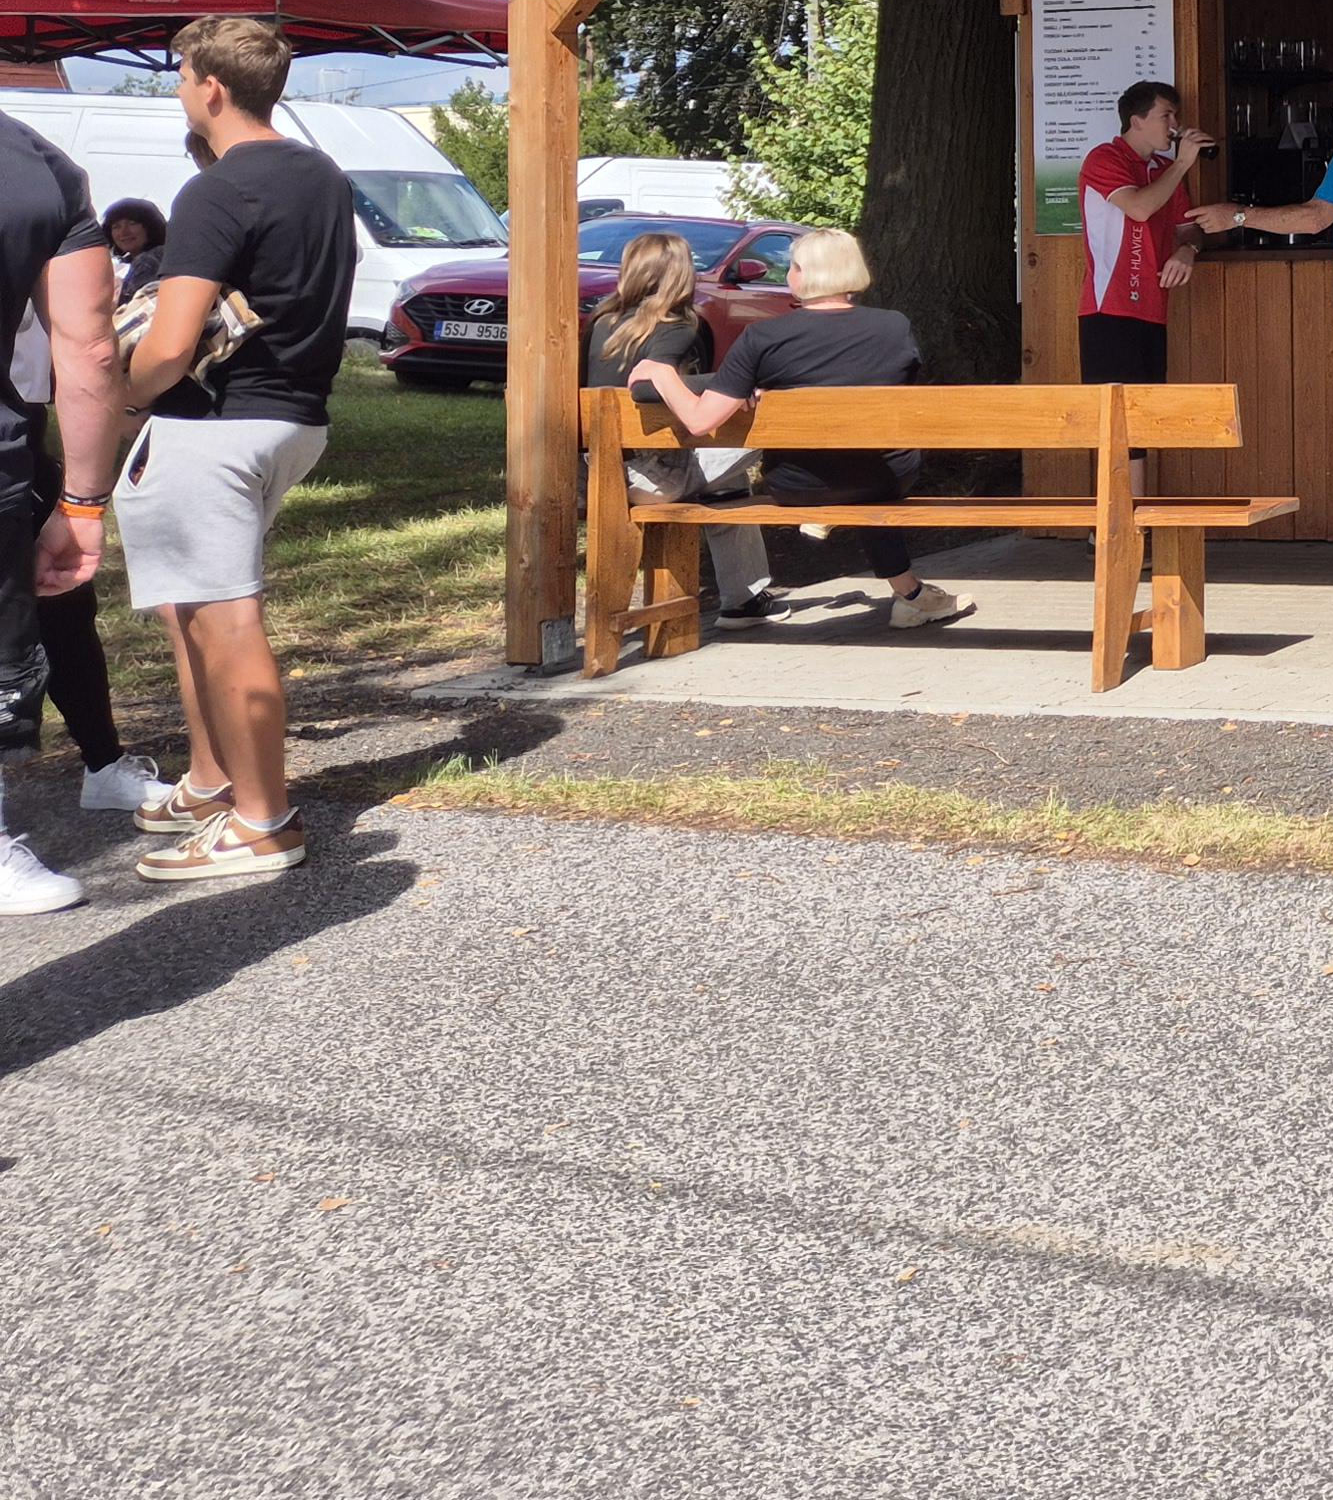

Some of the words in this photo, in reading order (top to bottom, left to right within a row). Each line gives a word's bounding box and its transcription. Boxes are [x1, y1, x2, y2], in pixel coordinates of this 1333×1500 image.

[1131, 226, 1143, 270] HLAVICE
[1130, 272, 1140, 287] SK
[445, 323, 468, 337] 5SJ
[477, 325, 507, 339] 9536
